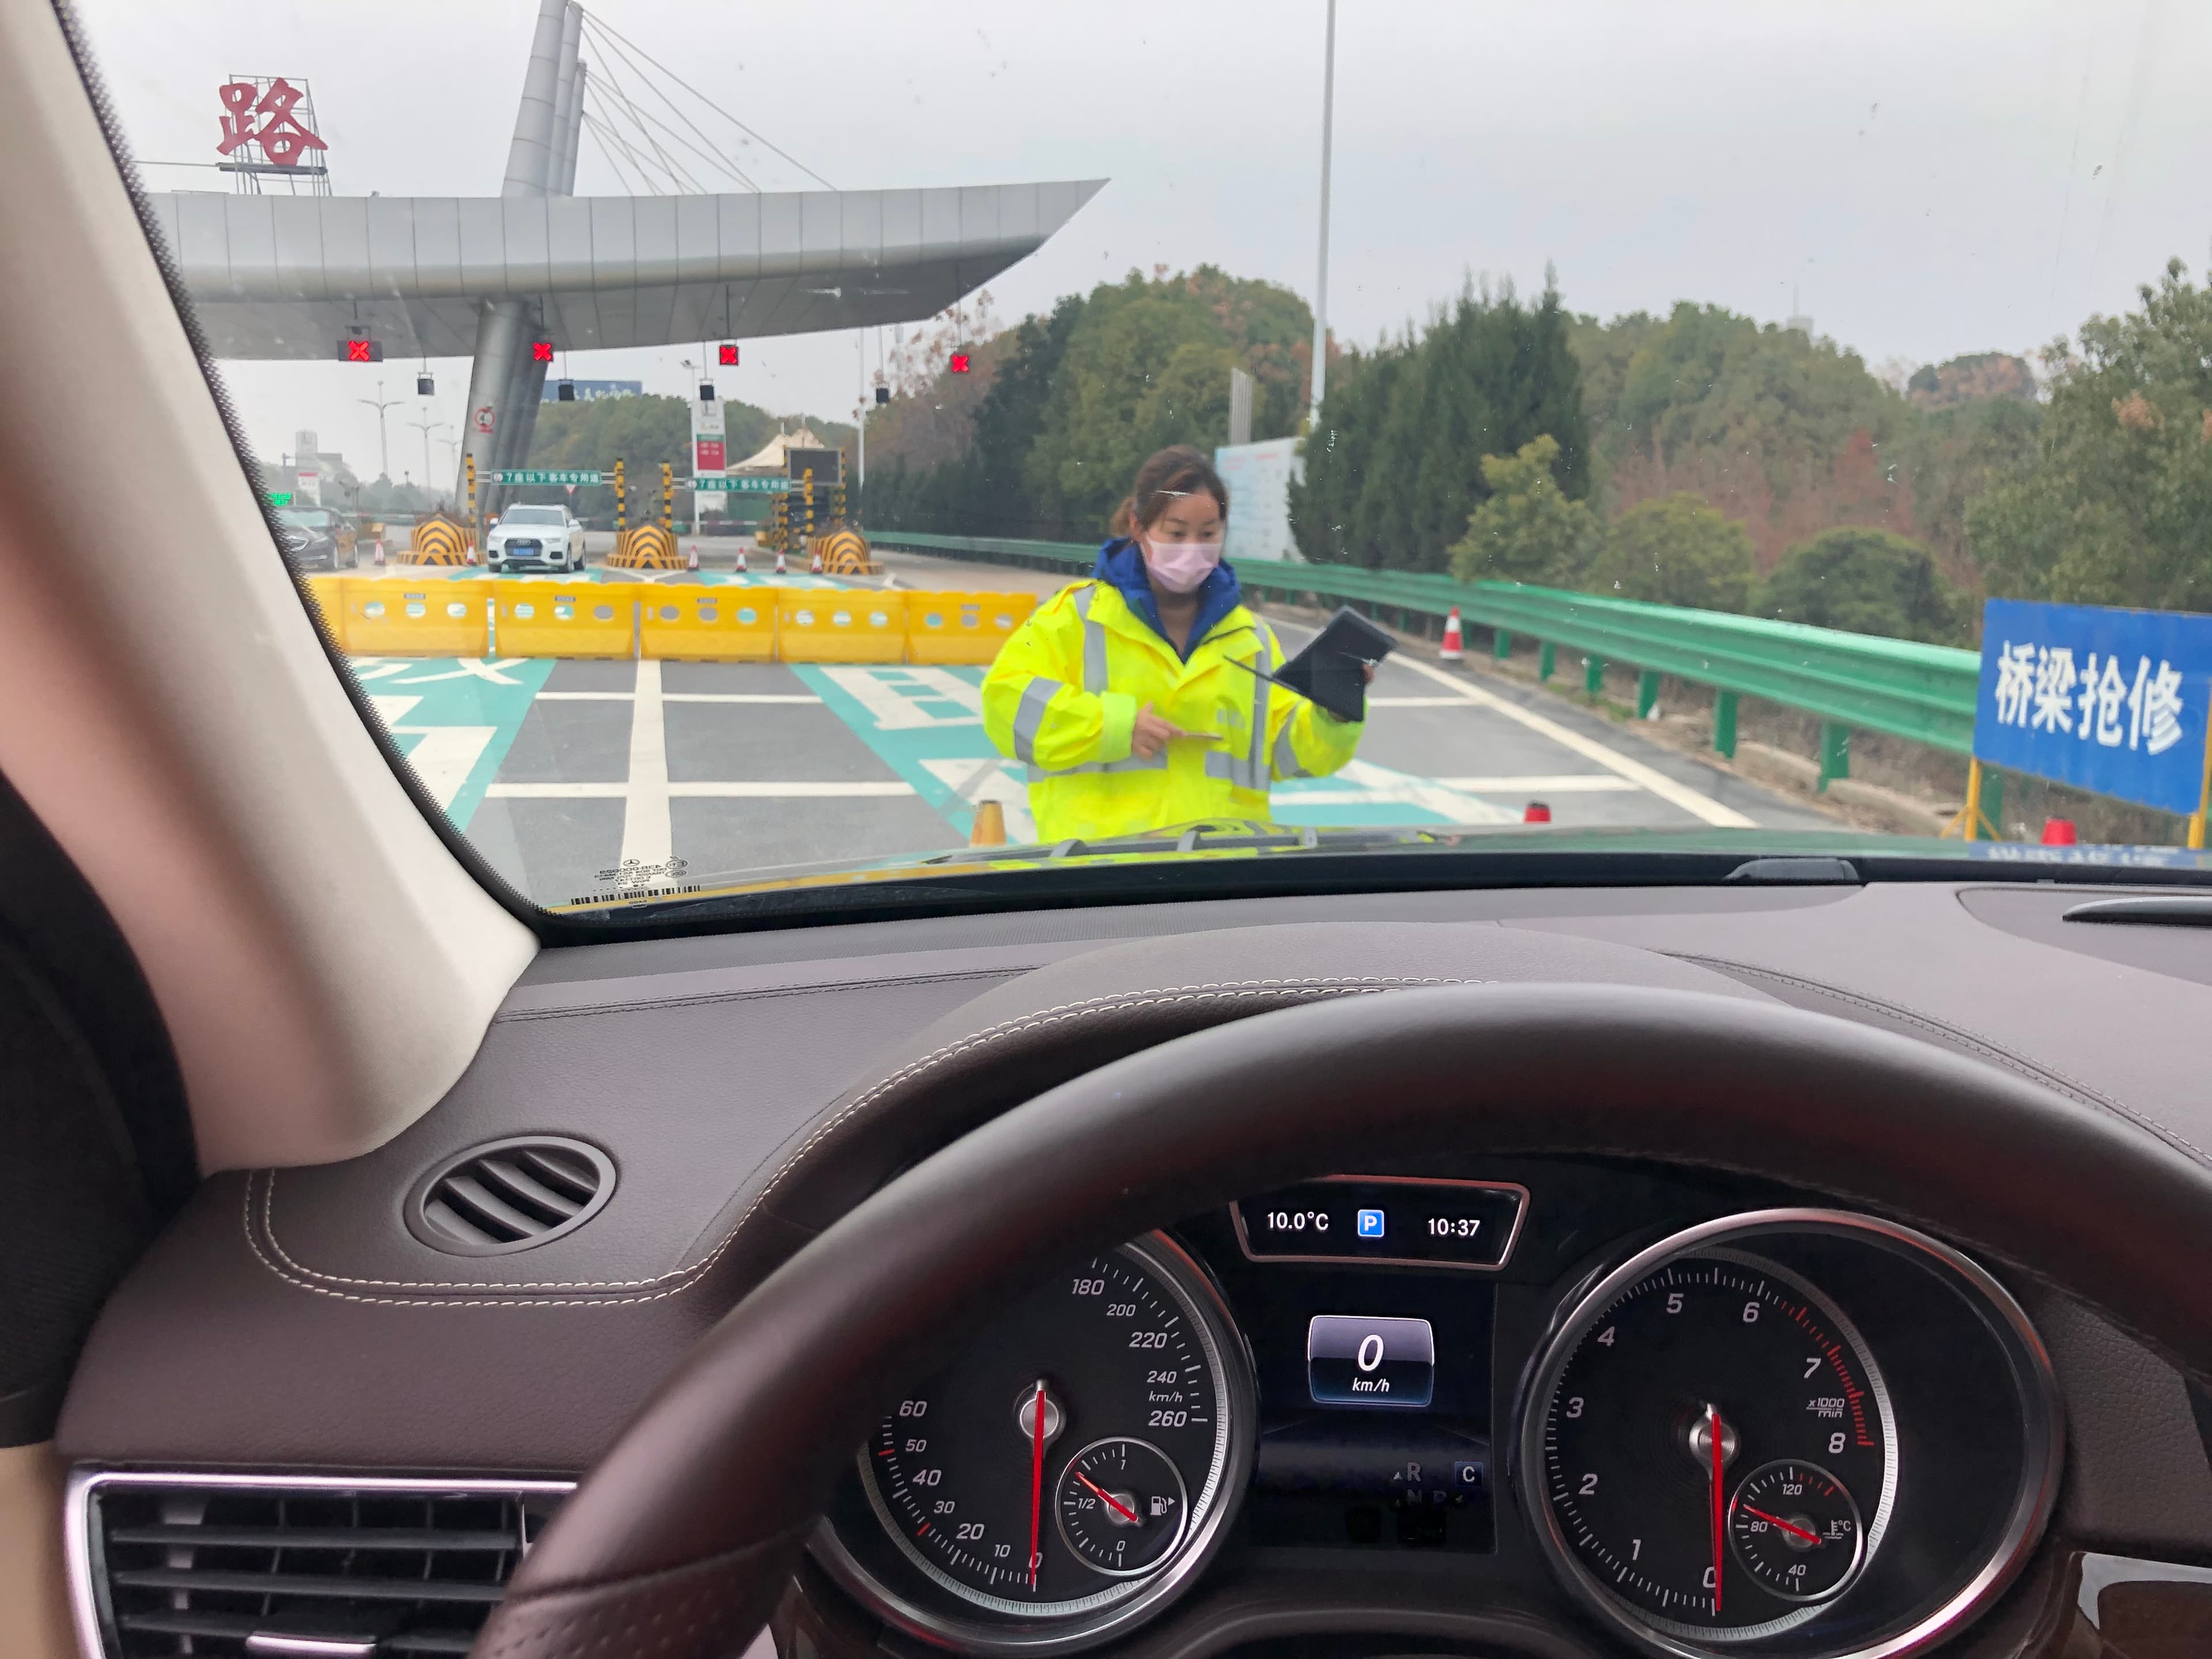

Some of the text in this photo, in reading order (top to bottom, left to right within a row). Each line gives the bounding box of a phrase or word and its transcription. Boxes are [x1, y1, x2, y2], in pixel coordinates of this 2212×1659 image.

[217, 77, 328, 165] 路
[1995, 641, 2183, 755] 桥梁抢修
[1267, 1211, 1328, 1230] 10.0°C
[1364, 1215, 1377, 1231] P
[1428, 1218, 1480, 1236] 10:37
[1072, 1278, 1105, 1296] 180
[1106, 1304, 1137, 1317] 200
[1666, 1293, 1684, 1314] 5
[1743, 1301, 1760, 1323] 6
[1128, 1331, 1168, 1349] 220
[1597, 1327, 1615, 1347] 4
[1358, 1334, 1384, 1372] 0
[1804, 1357, 1821, 1379] 7
[1146, 1370, 1177, 1384] 240
[1351, 1377, 1390, 1392] km/h
[1149, 1391, 1183, 1403] km/h
[1808, 1397, 1845, 1407] x1000
[899, 1400, 927, 1417] 60
[1566, 1396, 1584, 1418] 3
[1818, 1407, 1843, 1418] min
[1148, 1410, 1187, 1427] 260
[905, 1438, 927, 1452] 50
[1828, 1432, 1846, 1454] 8
[1120, 1459, 1127, 1470] 1
[1407, 1462, 1421, 1482] R
[912, 1469, 942, 1486] 40
[1462, 1466, 1475, 1482] C
[1578, 1473, 1598, 1495] 2
[1782, 1483, 1802, 1496] 120
[933, 1500, 955, 1514] 30
[1078, 1498, 1096, 1510] 1/2
[956, 1522, 985, 1540] 20
[1750, 1521, 1768, 1533] 80
[994, 1544, 1011, 1558] 10
[1116, 1540, 1126, 1552] 0
[1631, 1539, 1642, 1560] 1
[1028, 1552, 1043, 1569] 0
[1788, 1564, 1807, 1577] 40
